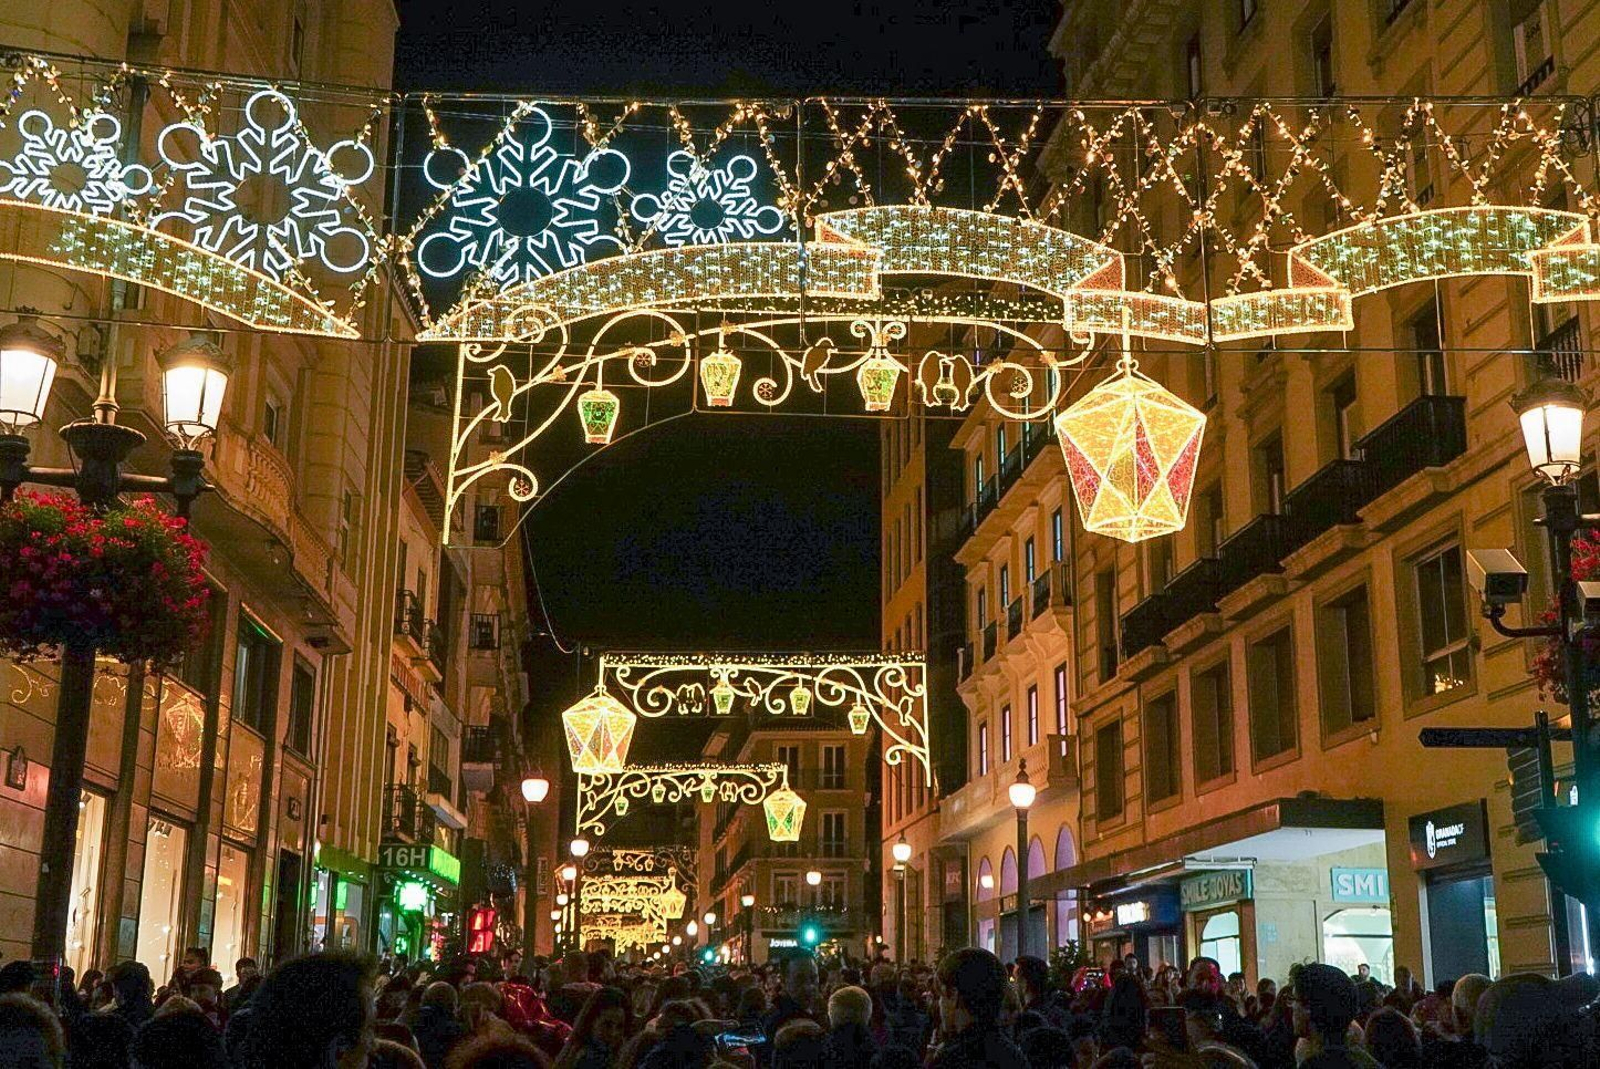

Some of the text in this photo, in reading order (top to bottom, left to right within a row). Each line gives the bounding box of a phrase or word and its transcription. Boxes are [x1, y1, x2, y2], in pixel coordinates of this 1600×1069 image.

[383, 847, 426, 867] 16H
[1181, 872, 1242, 905] SMILE JOYAS
